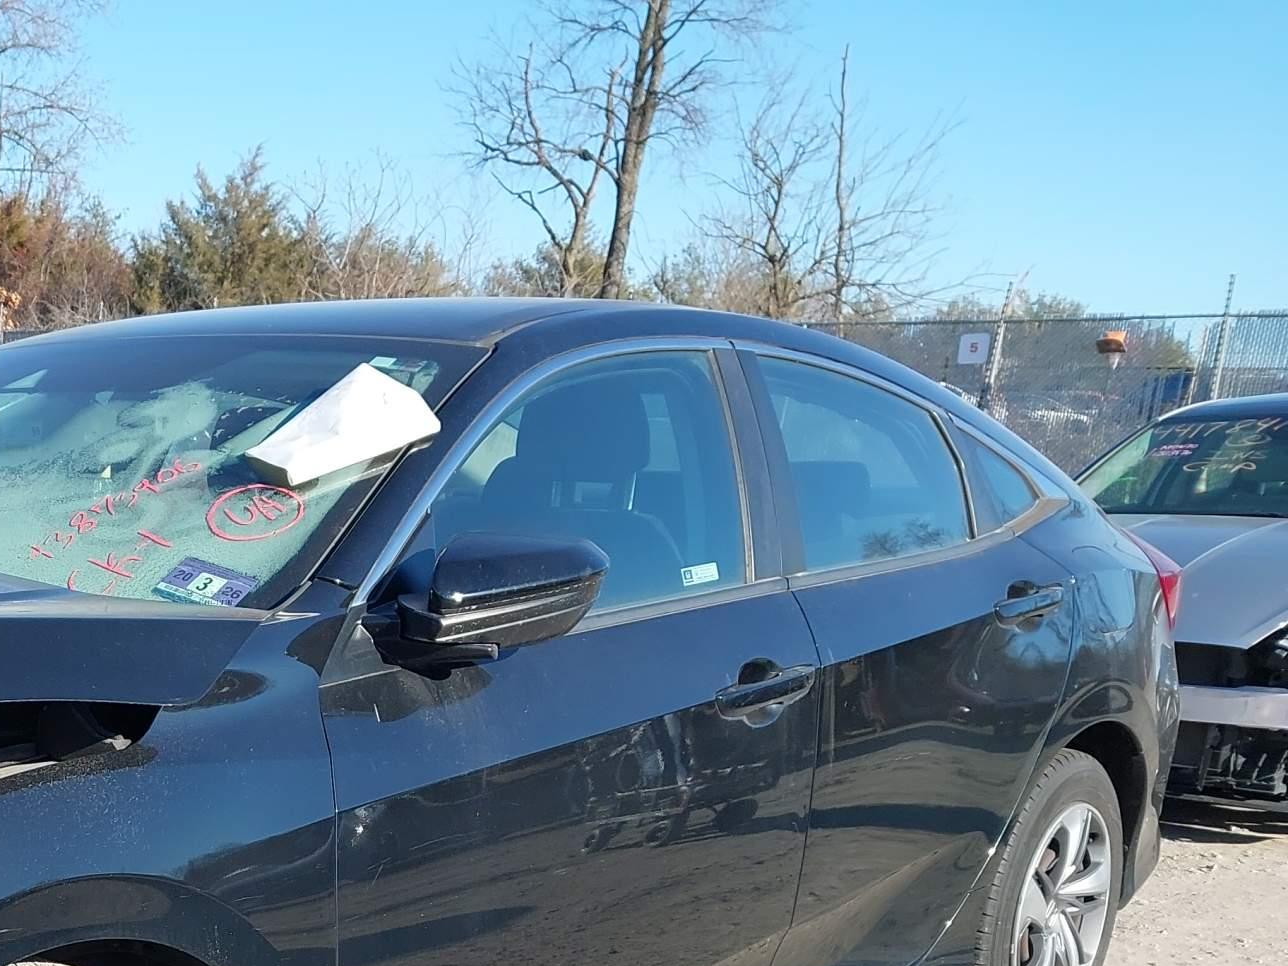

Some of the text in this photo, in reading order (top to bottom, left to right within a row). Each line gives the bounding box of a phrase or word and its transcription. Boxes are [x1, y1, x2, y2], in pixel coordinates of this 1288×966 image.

[969, 342, 979, 353] 5
[173, 569, 194, 582] 20
[195, 577, 213, 592] 3
[221, 586, 243, 600] 26
